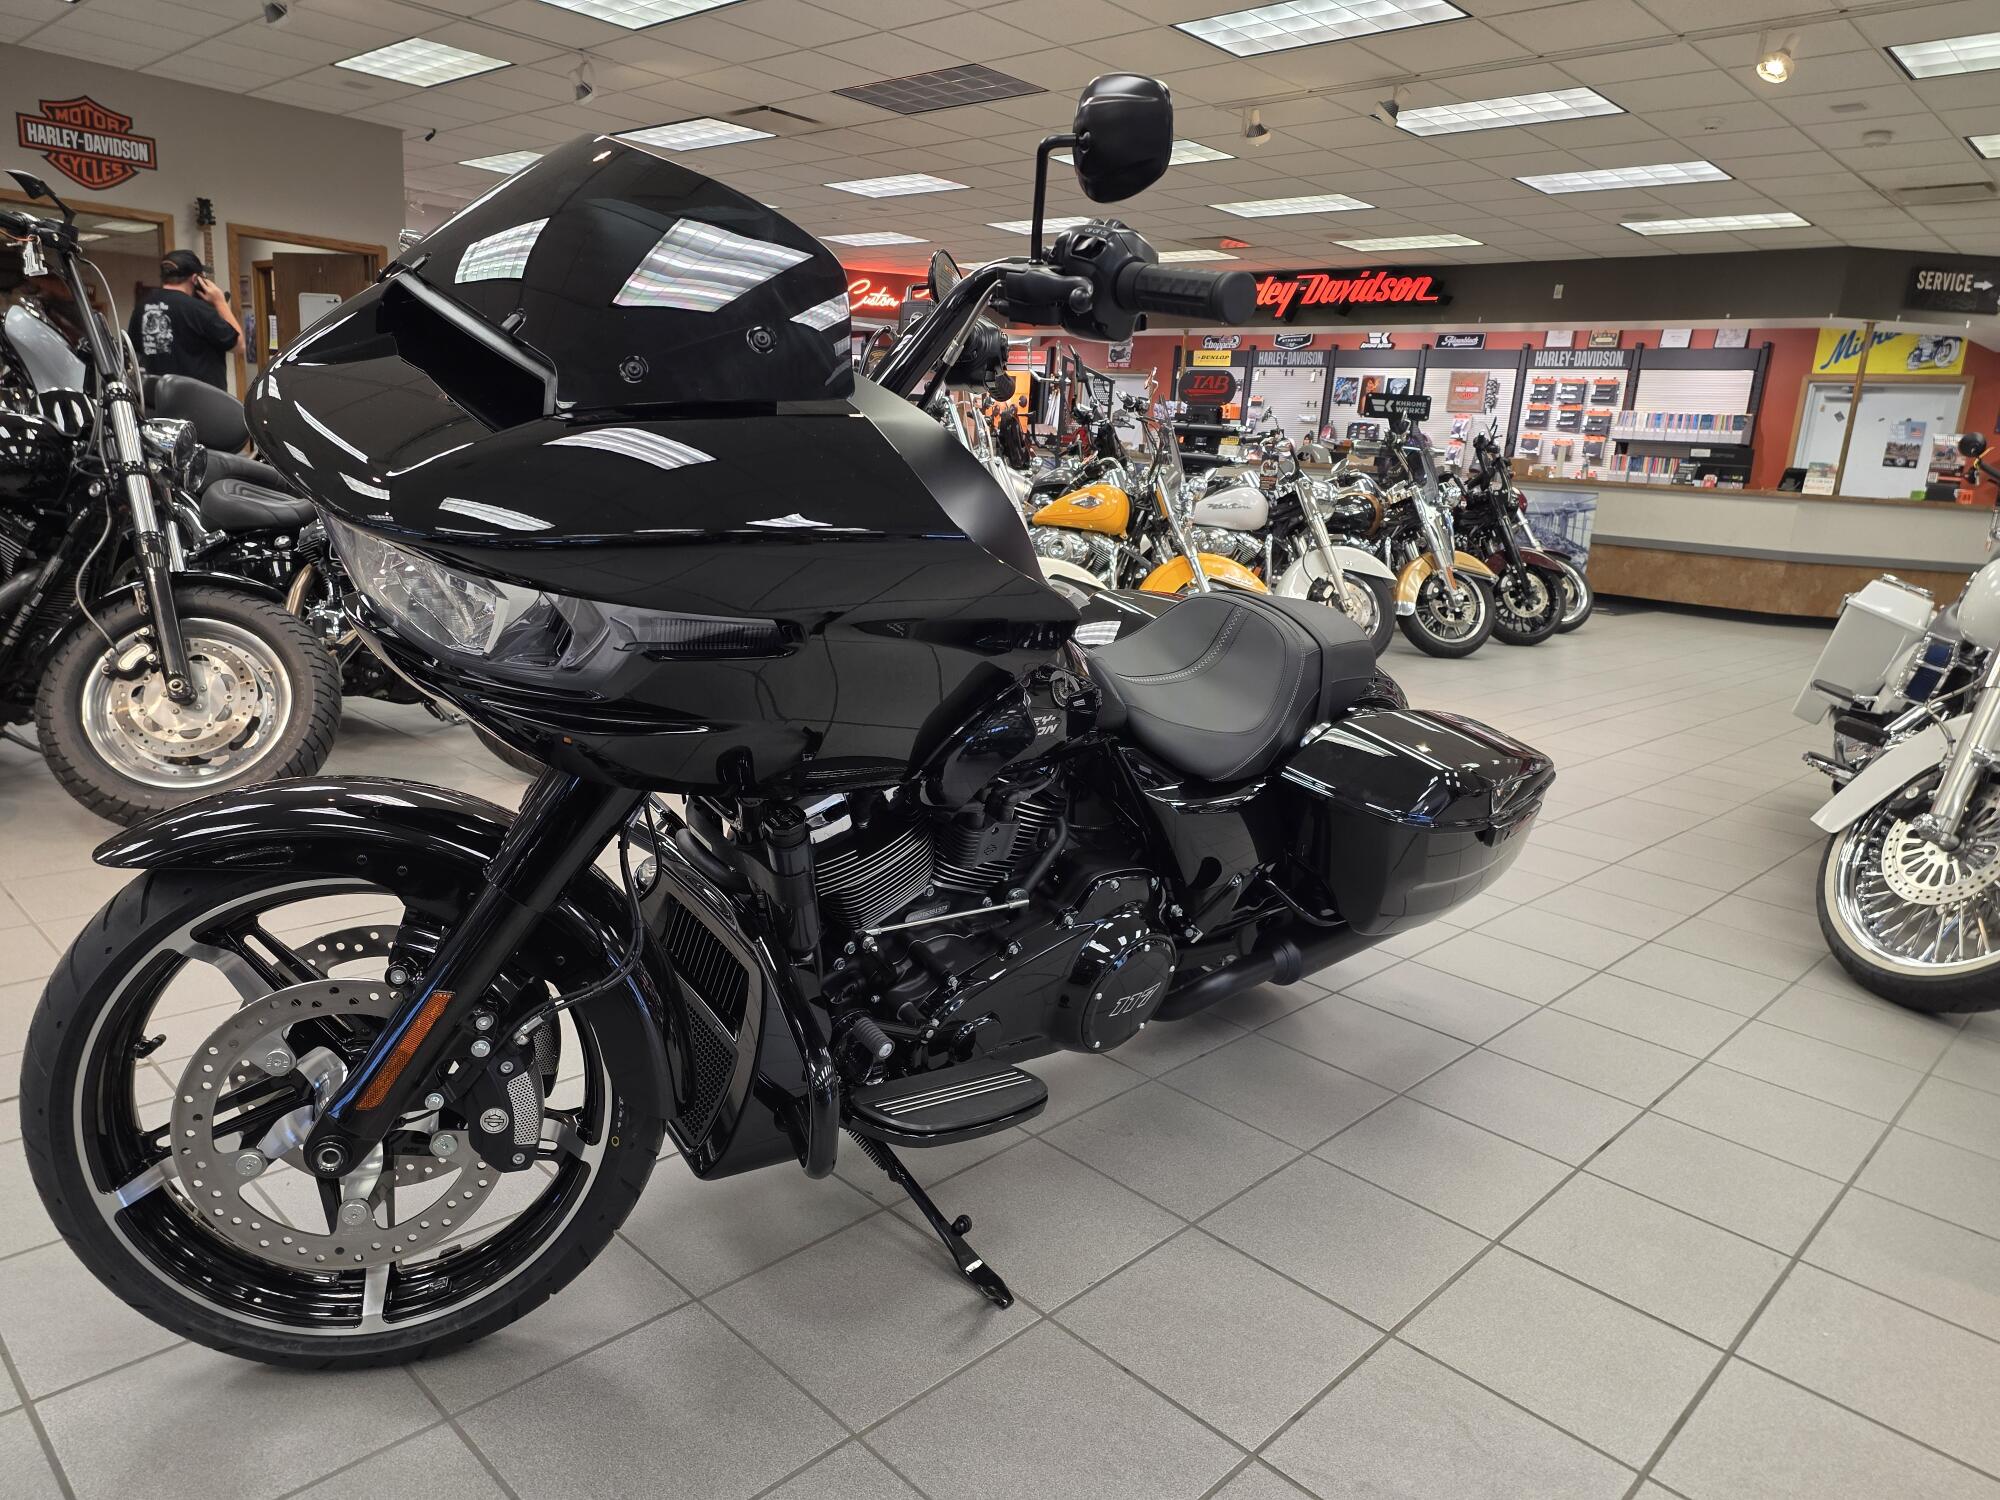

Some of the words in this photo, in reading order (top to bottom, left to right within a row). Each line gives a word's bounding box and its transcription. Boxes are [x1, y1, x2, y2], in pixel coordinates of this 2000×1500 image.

[55, 104, 121, 132] MOTOR
[26, 122, 149, 162] HARLEY-DAVIDSON
[59, 152, 122, 183] CYCLES
[1917, 270, 1974, 292] SERVICE
[1256, 271, 1439, 318] ley-Davidson
[1258, 351, 1324, 366] HARLEY-DAVIDSON
[1534, 350, 1625, 367] HARLEY-DAVIDSON
[1193, 375, 1230, 391] TAB
[1395, 400, 1427, 408] KHROME
[1395, 406, 1426, 415] WERKS
[1108, 981, 1161, 1017] 117
